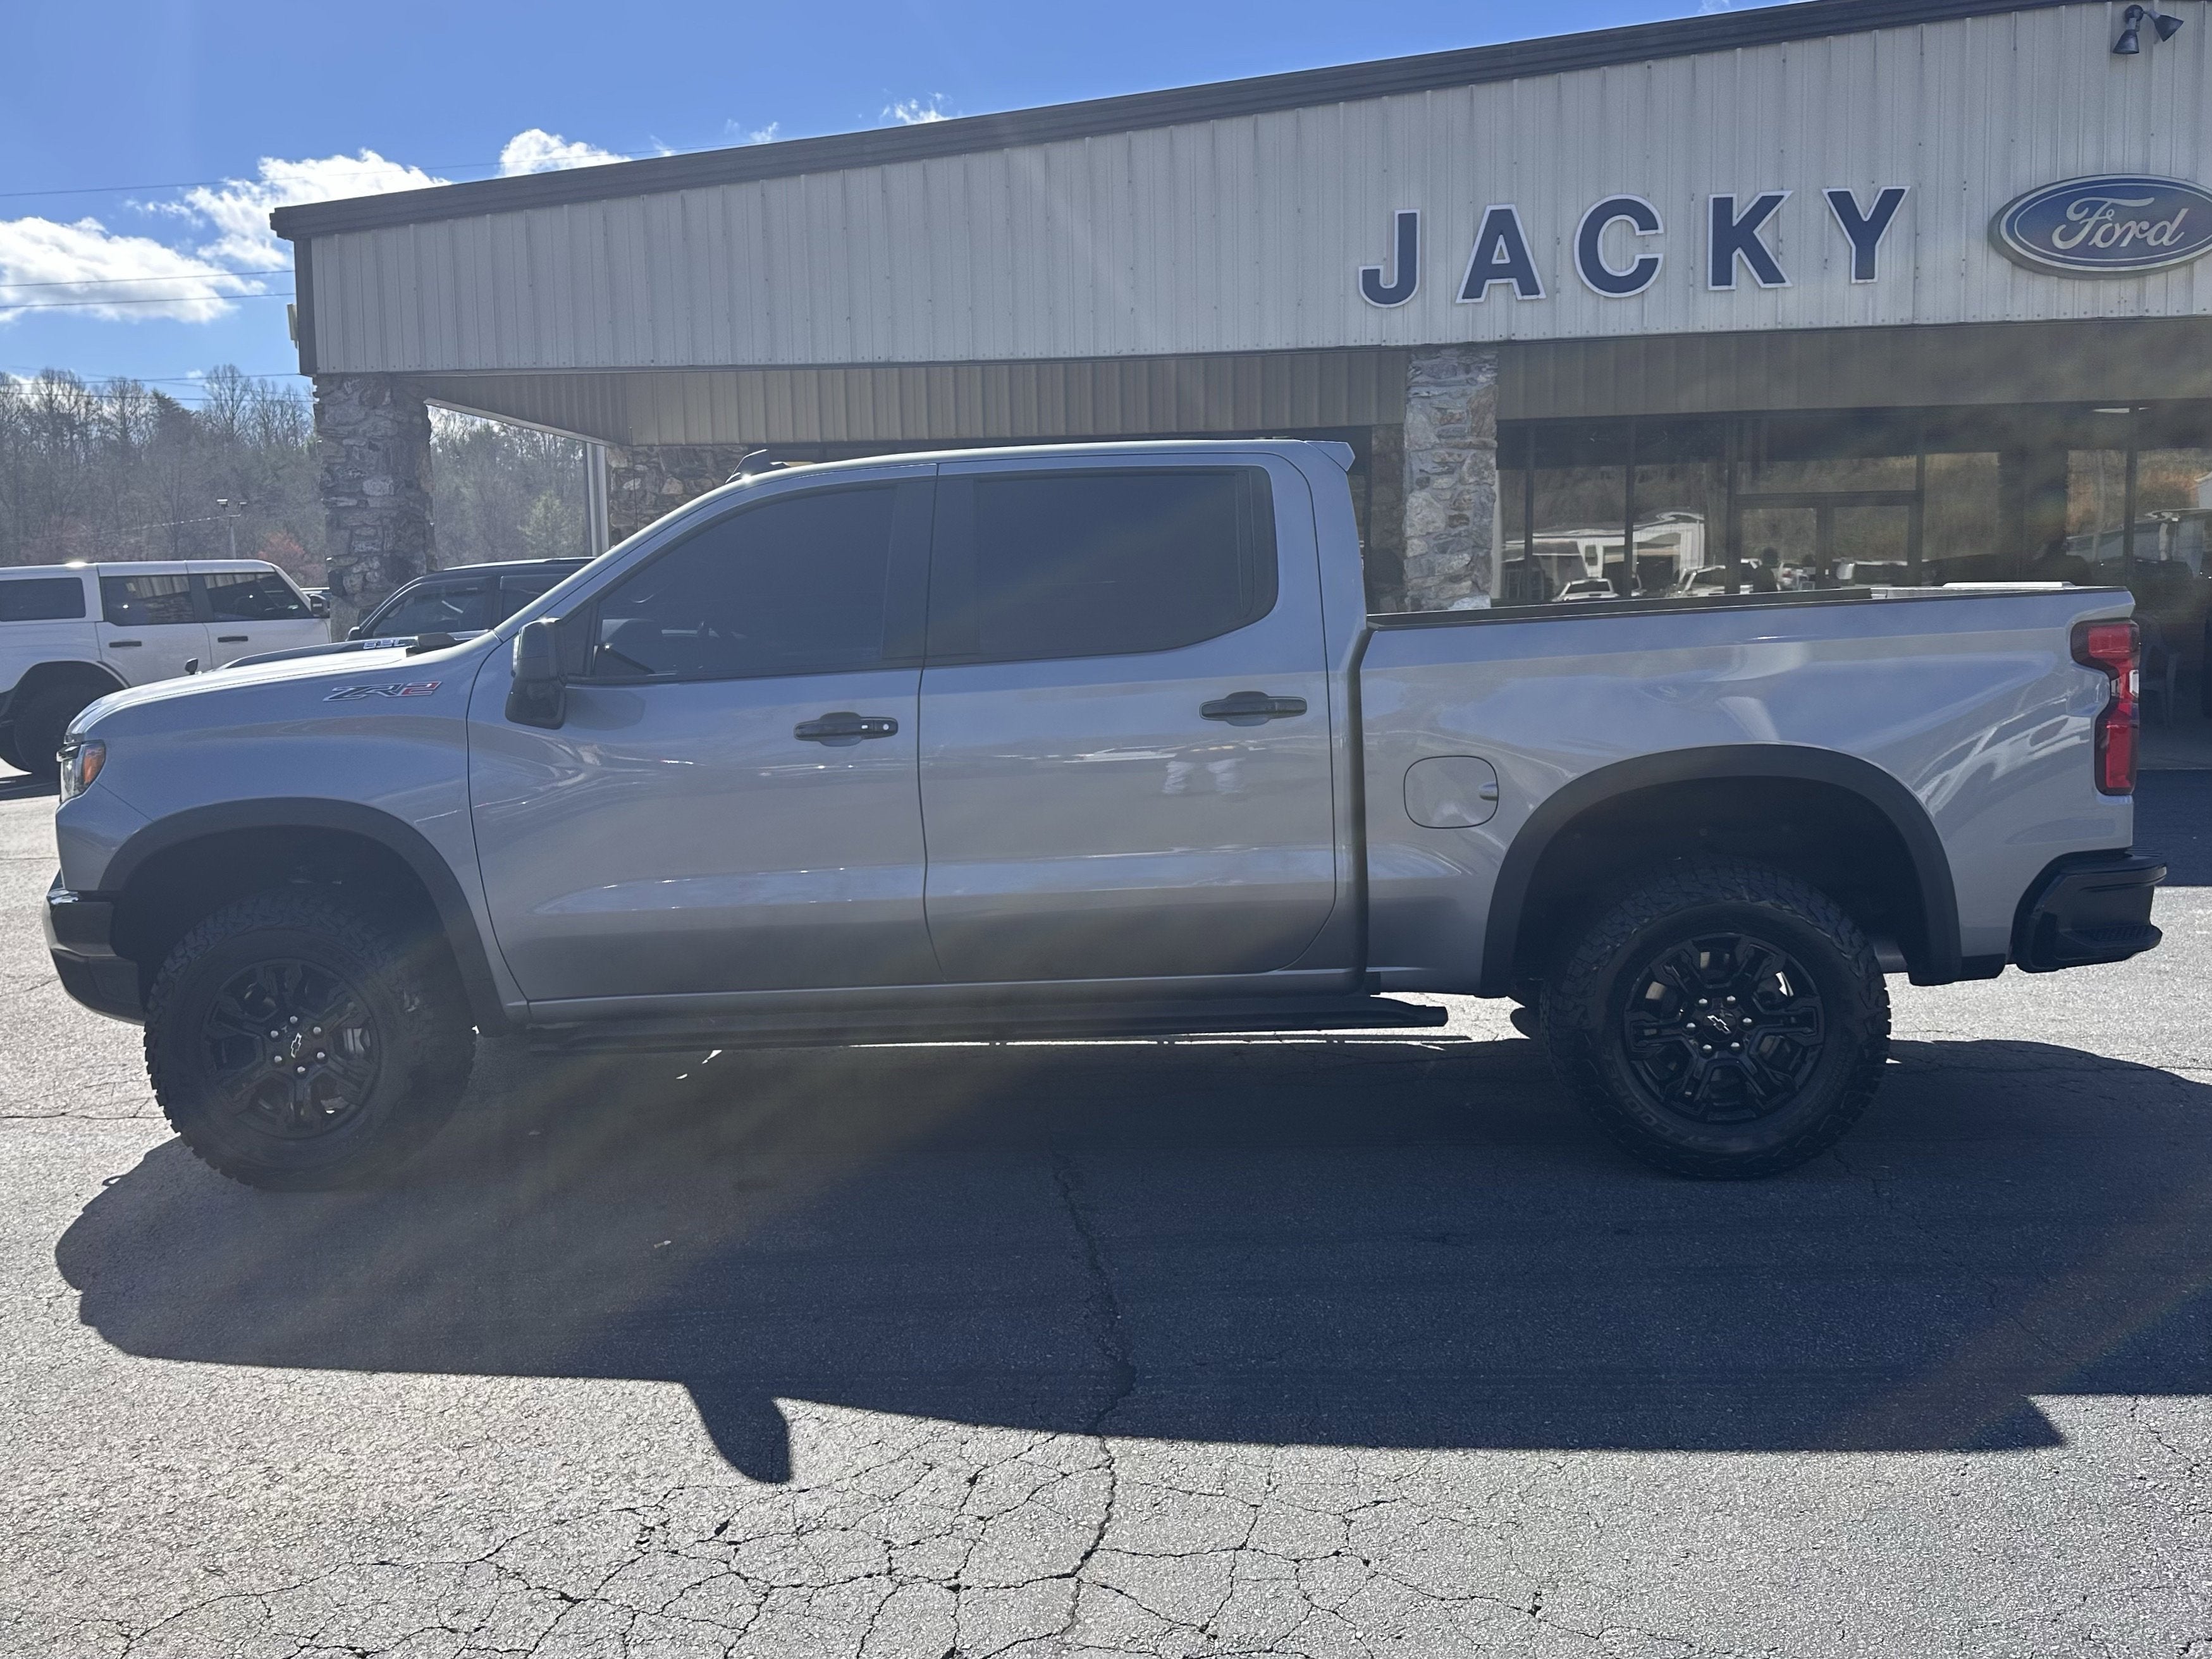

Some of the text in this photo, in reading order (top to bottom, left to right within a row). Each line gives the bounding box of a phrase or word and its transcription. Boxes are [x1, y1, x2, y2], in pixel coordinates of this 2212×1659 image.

[1358, 187, 1910, 308] JACKY
[2051, 197, 2189, 250] Ford
[323, 681, 442, 702] ZR2
